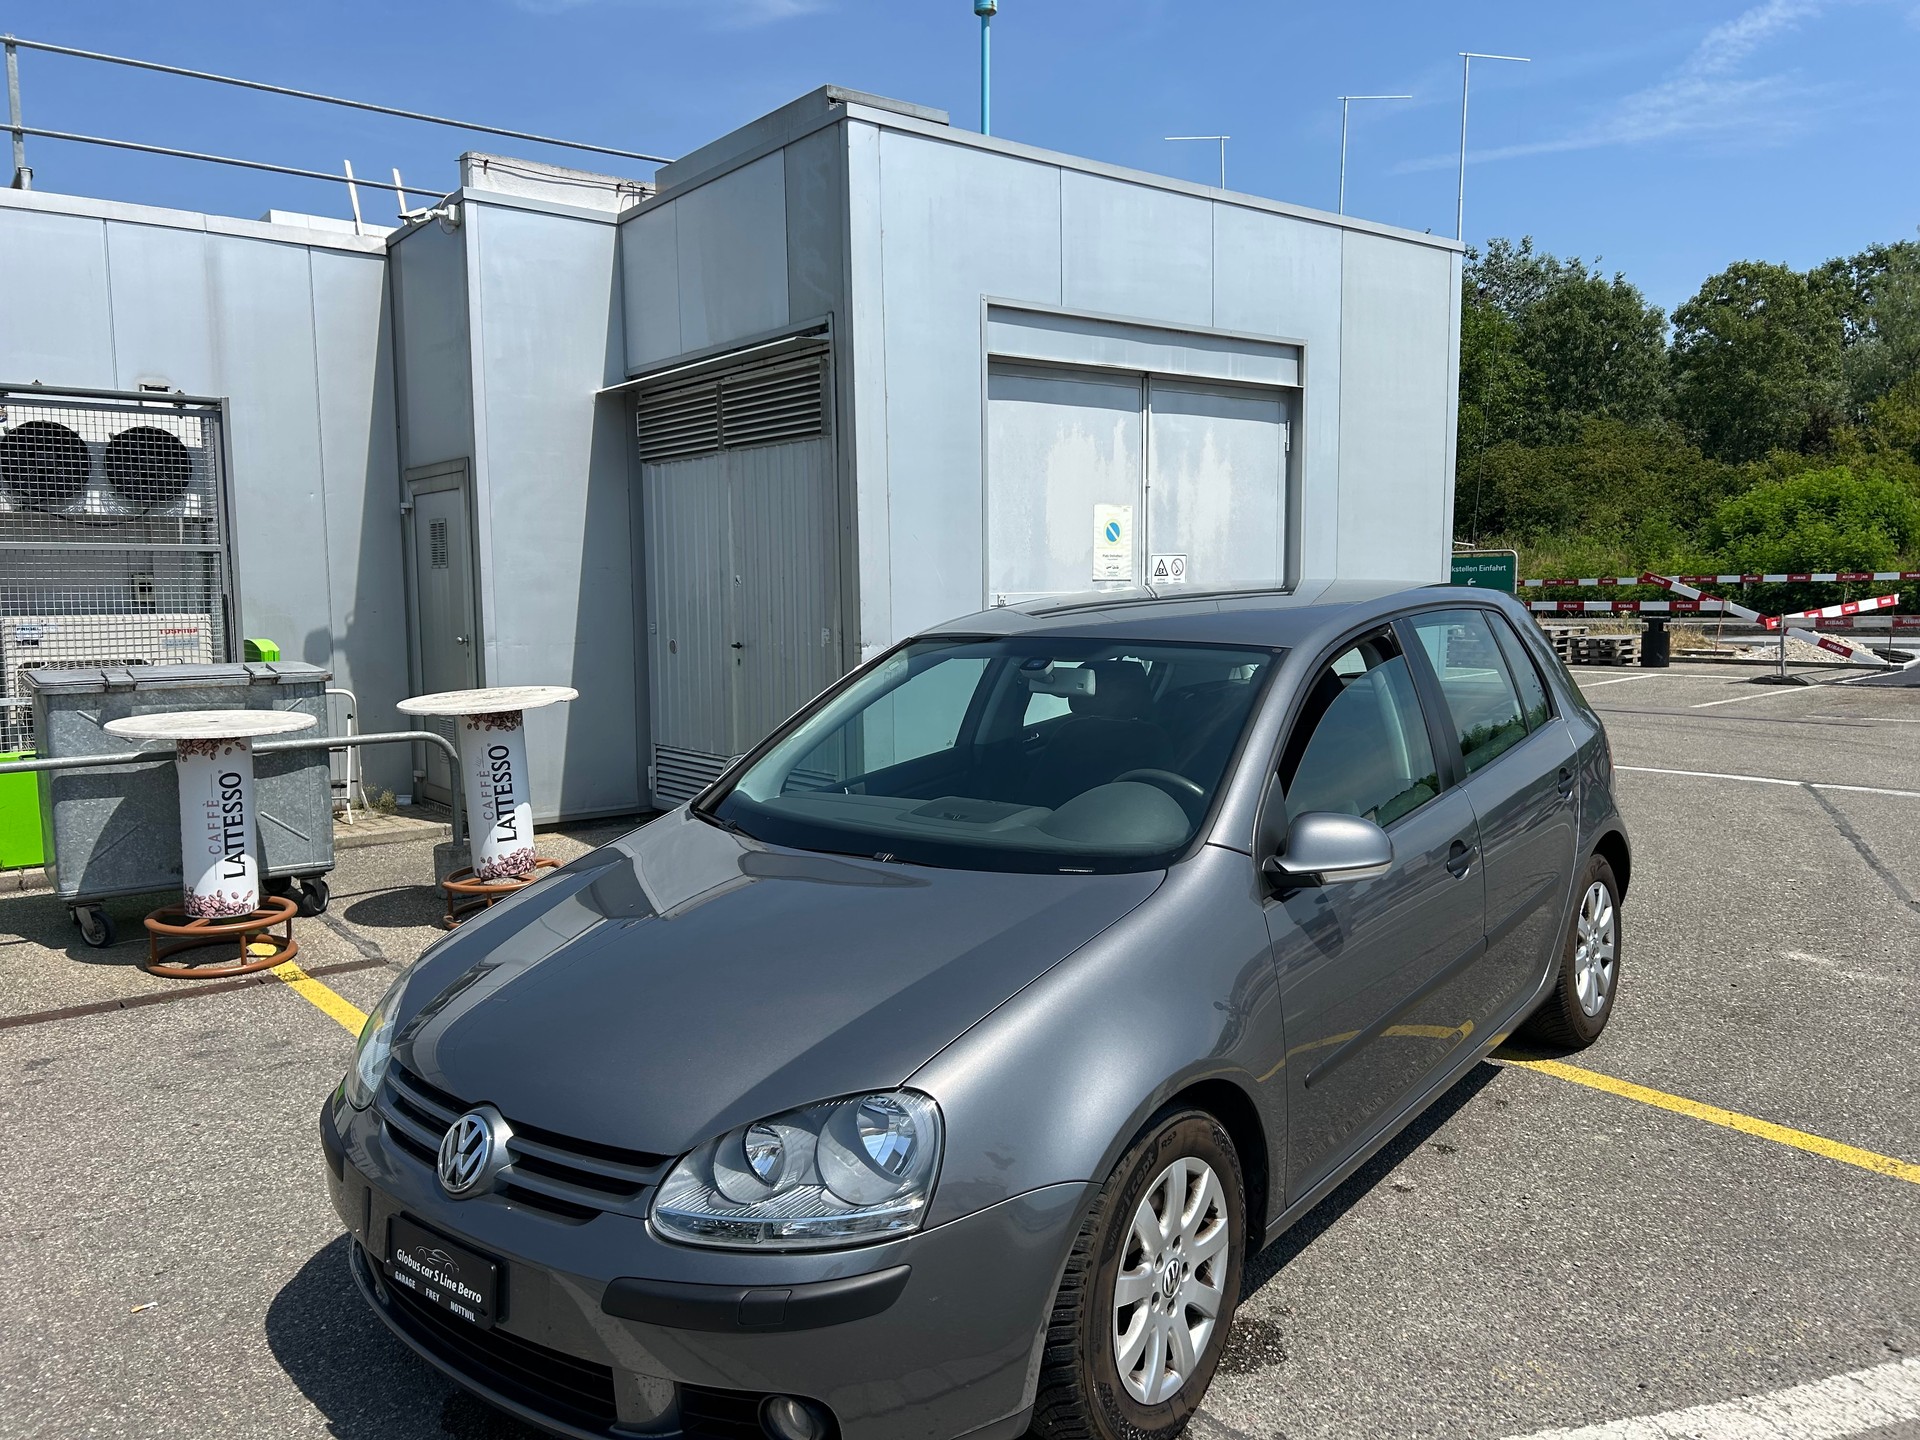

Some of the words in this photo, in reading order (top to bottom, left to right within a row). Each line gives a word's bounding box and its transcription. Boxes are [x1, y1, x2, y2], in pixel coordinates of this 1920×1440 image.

[1479, 564, 1507, 572] Einfahrt
[1826, 643, 1844, 653] KIBAG
[476, 770, 495, 820] CAFFÈ
[488, 745, 518, 843] LATTESSO
[202, 800, 222, 855] CAFFÈ
[218, 772, 246, 880] LATTESSO
[395, 1271, 416, 1289] GARAGE
[425, 1287, 440, 1303] FREY
[450, 1301, 476, 1322] NOTTWIL
[396, 1249, 421, 1272] Globus
[421, 1265, 434, 1279] car
[434, 1269, 440, 1282] S
[439, 1272, 457, 1292] Line
[457, 1281, 482, 1304] Berro
